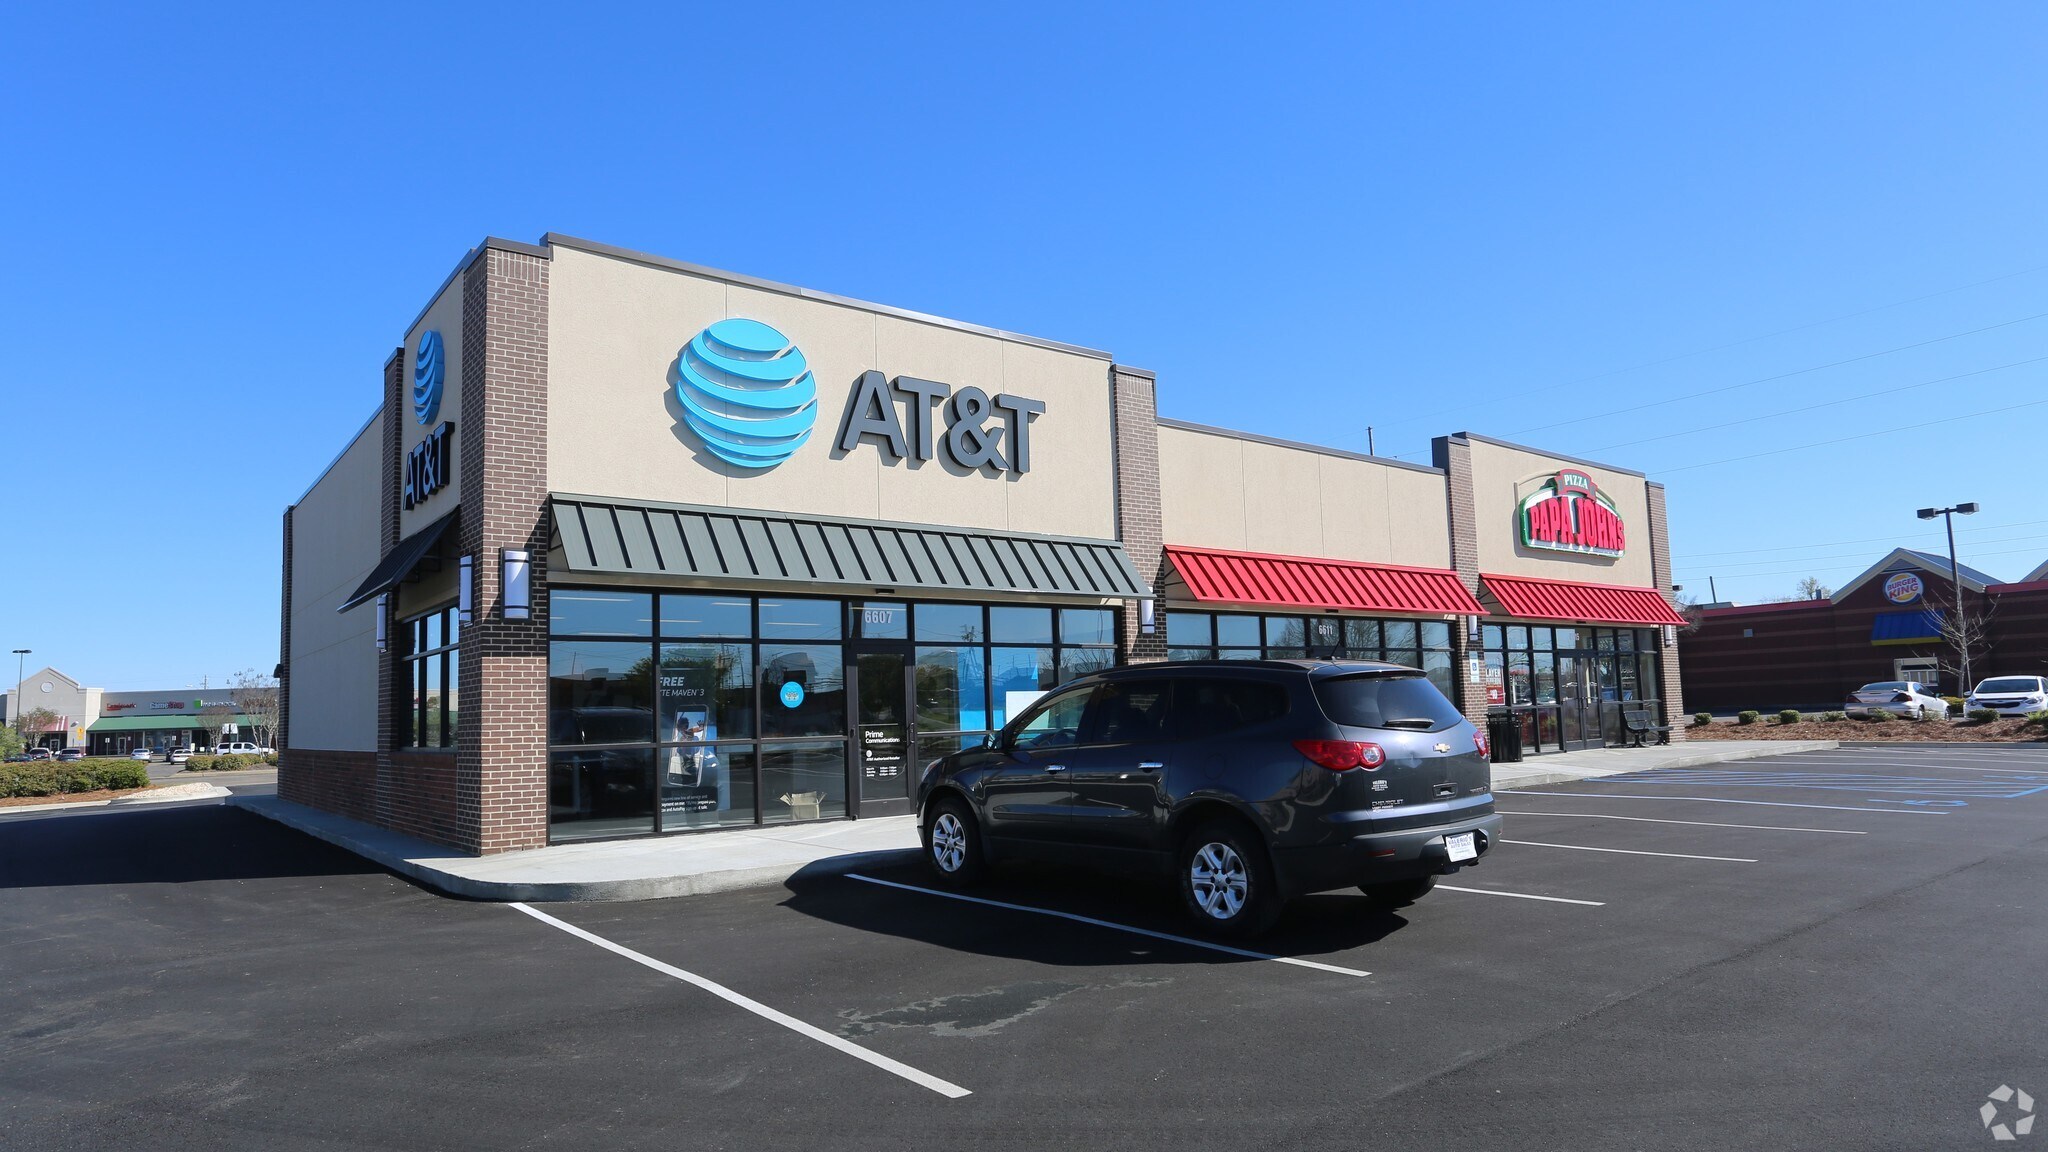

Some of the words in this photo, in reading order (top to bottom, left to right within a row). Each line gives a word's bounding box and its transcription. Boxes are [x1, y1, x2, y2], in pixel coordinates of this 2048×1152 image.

[838, 369, 1046, 475] AT&T
[403, 421, 455, 511] AT&T
[1563, 474, 1589, 490] PIZZA
[1529, 496, 1575, 545] PAPA
[1887, 577, 1917, 591] BURGER
[1889, 583, 1919, 599] KING
[864, 610, 893, 624] 6607
[1318, 624, 1333, 635] 6611
[660, 676, 685, 687] FREE
[700, 688, 705, 697] 3
[149, 701, 185, 710] GameStop
[865, 730, 883, 738] Prime
